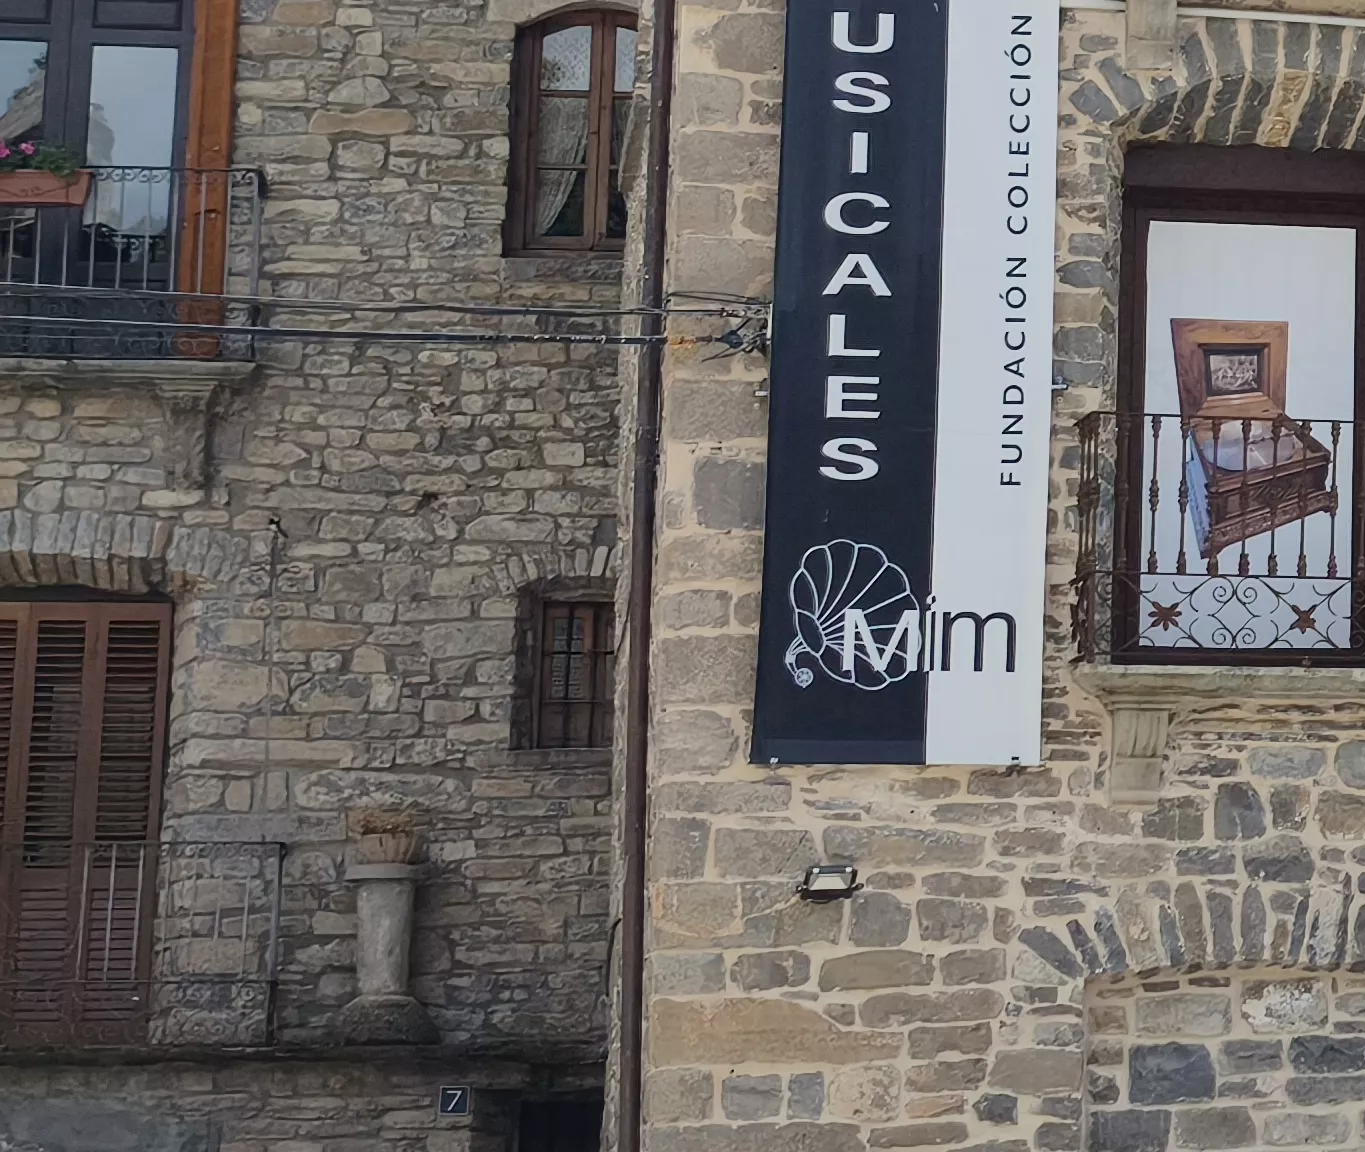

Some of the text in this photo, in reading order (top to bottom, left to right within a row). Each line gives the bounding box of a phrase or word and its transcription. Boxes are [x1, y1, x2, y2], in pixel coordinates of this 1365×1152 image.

[1004, 15, 1033, 235] COLECCIÓN
[999, 256, 1028, 487] FUNDACIÓN
[841, 593, 1017, 673] Mim
[445, 1090, 462, 1112] 7
